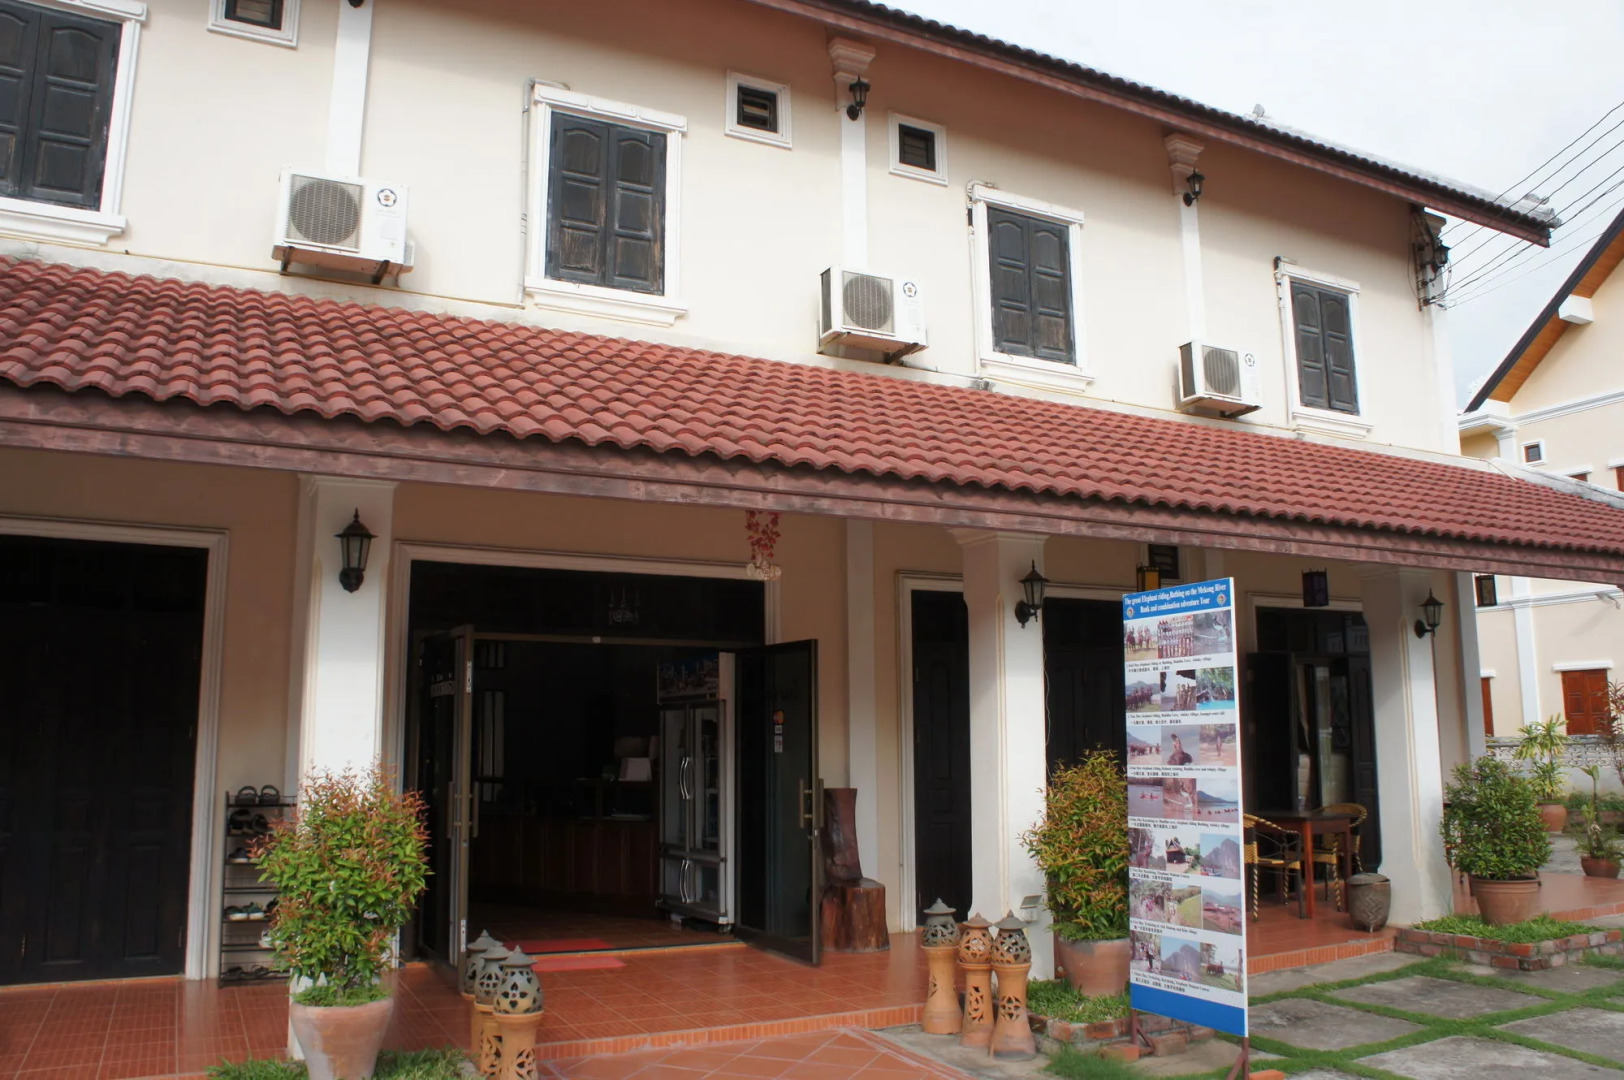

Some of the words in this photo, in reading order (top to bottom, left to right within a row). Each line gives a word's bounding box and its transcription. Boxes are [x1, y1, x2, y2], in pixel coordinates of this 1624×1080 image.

[1132, 597, 1141, 606] great
[1142, 594, 1157, 604] Elephant
[1198, 586, 1214, 594] Mekong
[1158, 601, 1180, 611] combination
